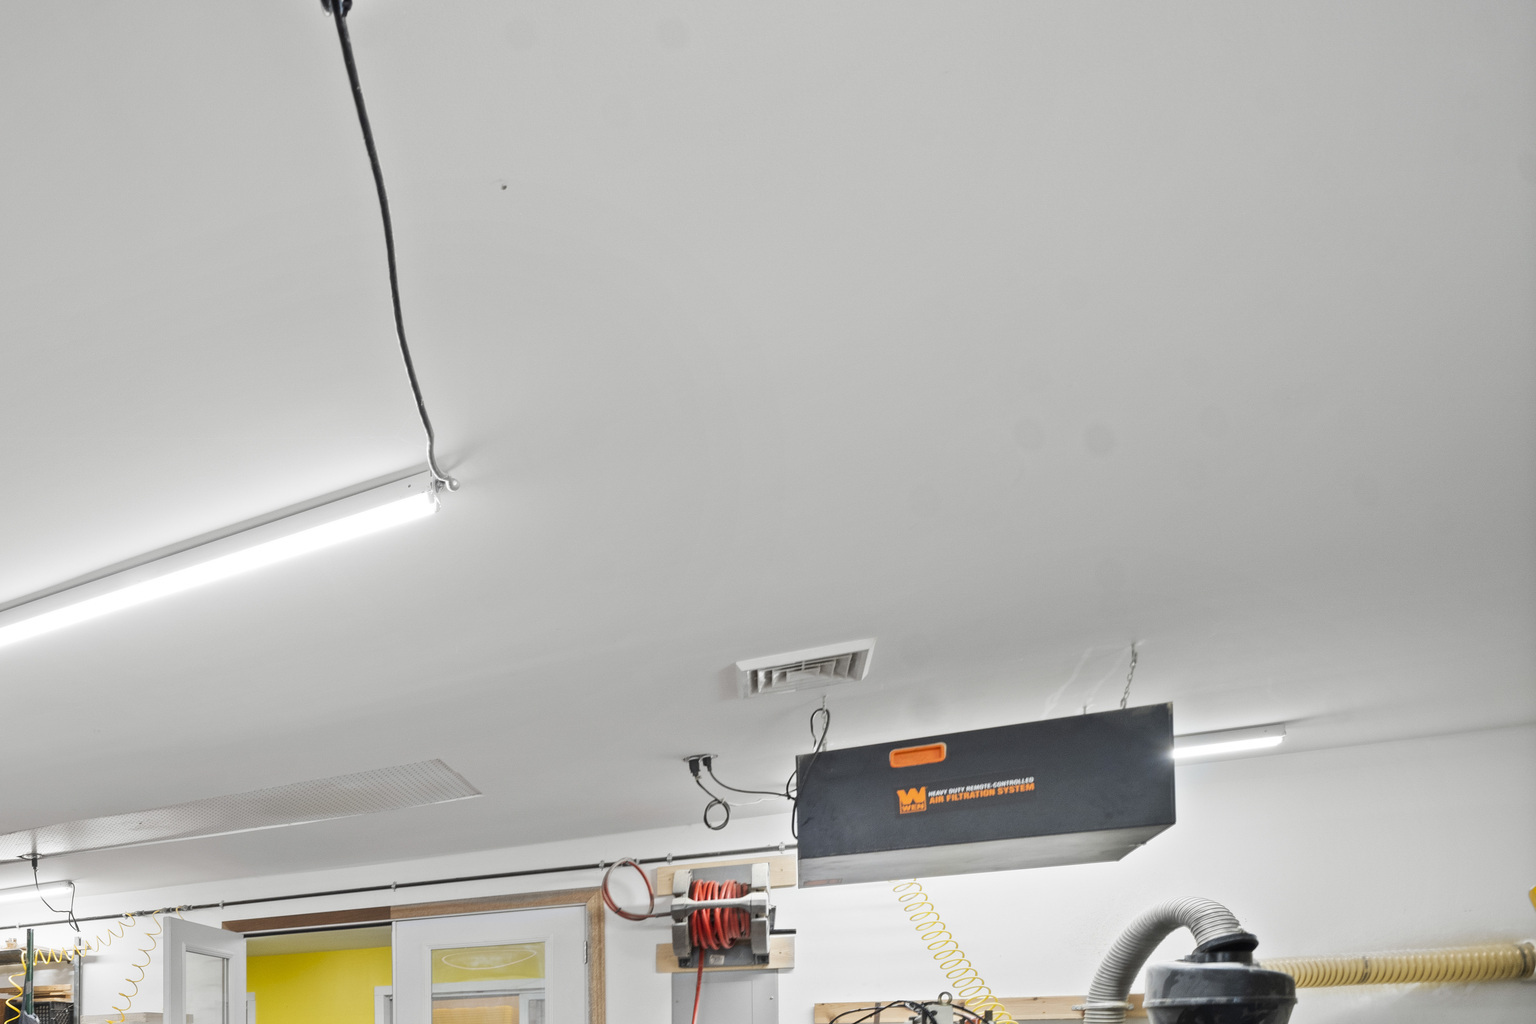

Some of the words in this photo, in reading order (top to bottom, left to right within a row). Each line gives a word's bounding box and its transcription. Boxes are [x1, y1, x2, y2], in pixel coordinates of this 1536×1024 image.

[928, 789, 948, 798] HEAVY
[948, 786, 965, 794] DUTY
[966, 776, 1035, 792] REMOTE-CONTROLLED
[929, 796, 945, 804] AIR
[946, 789, 996, 803] FILTRATION
[997, 782, 1035, 796] SYSTEM
